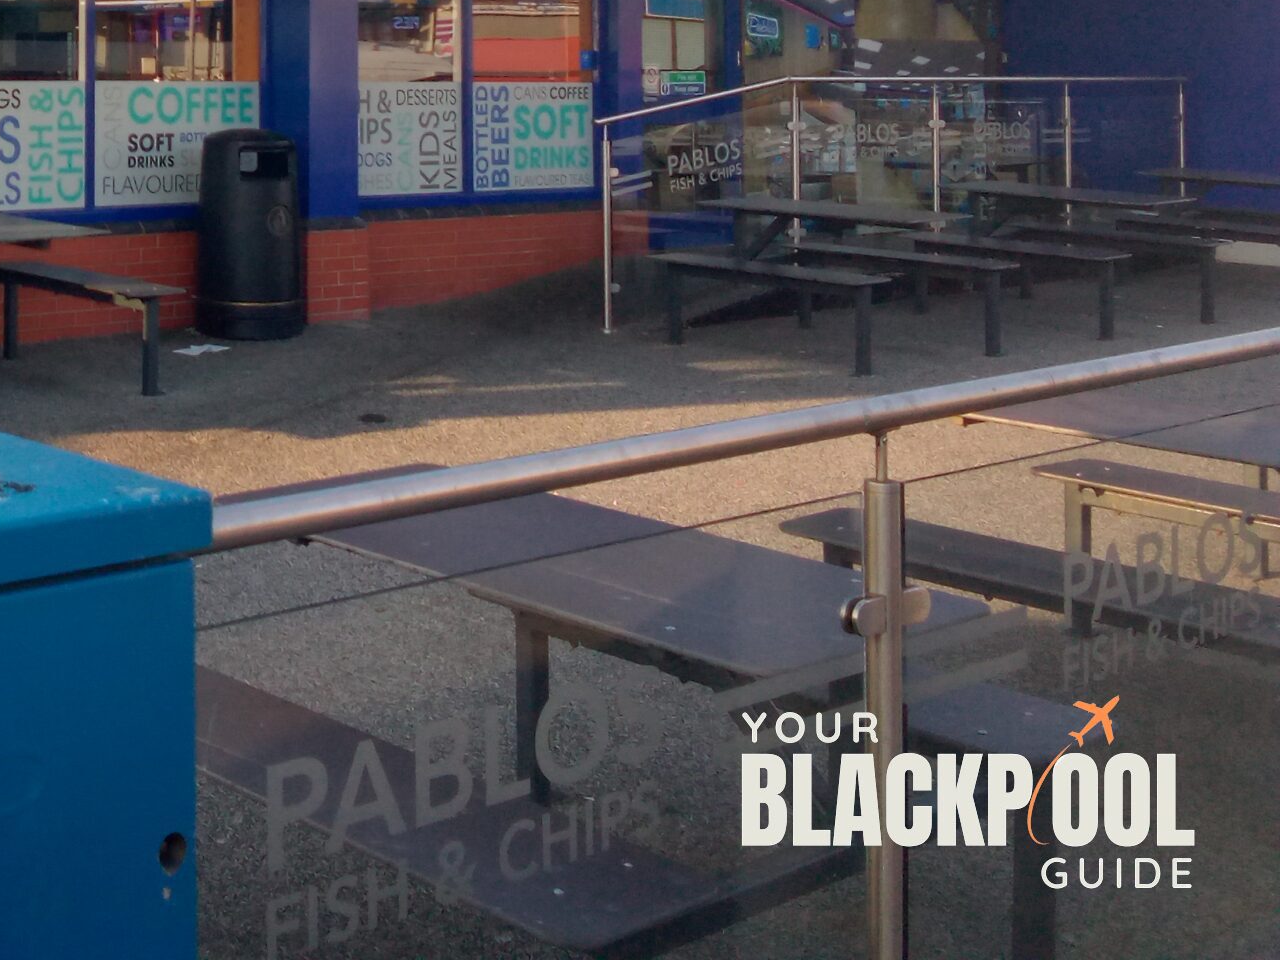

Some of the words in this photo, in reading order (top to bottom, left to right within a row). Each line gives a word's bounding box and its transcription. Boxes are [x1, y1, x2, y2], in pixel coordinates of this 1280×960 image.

[28, 88, 54, 113] &
[128, 86, 254, 124] COFFEE
[396, 88, 457, 106] DESSERTS
[514, 87, 548, 102] CANS
[550, 86, 589, 101] COFFEE
[103, 86, 122, 170] CANS
[180, 131, 207, 143] BOTT
[360, 118, 393, 145] IPS
[475, 85, 489, 189] BOTTLED
[492, 85, 510, 188] BEERS
[514, 104, 589, 140] SOFT
[57, 86, 85, 202] CHIPS
[128, 132, 175, 153] SOFT
[128, 154, 175, 169] DRINKS
[397, 111, 414, 191] CANS
[419, 110, 440, 189] KIDS
[442, 110, 458, 189] MEALS
[514, 145, 589, 170] DRINKS
[667, 139, 741, 177] PABLOS
[28, 124, 54, 204] FISH
[670, 176, 695, 193] FISH
[698, 172, 707, 186] &
[710, 163, 743, 182] CHIPS
[1064, 511, 1262, 630] PABLOS
